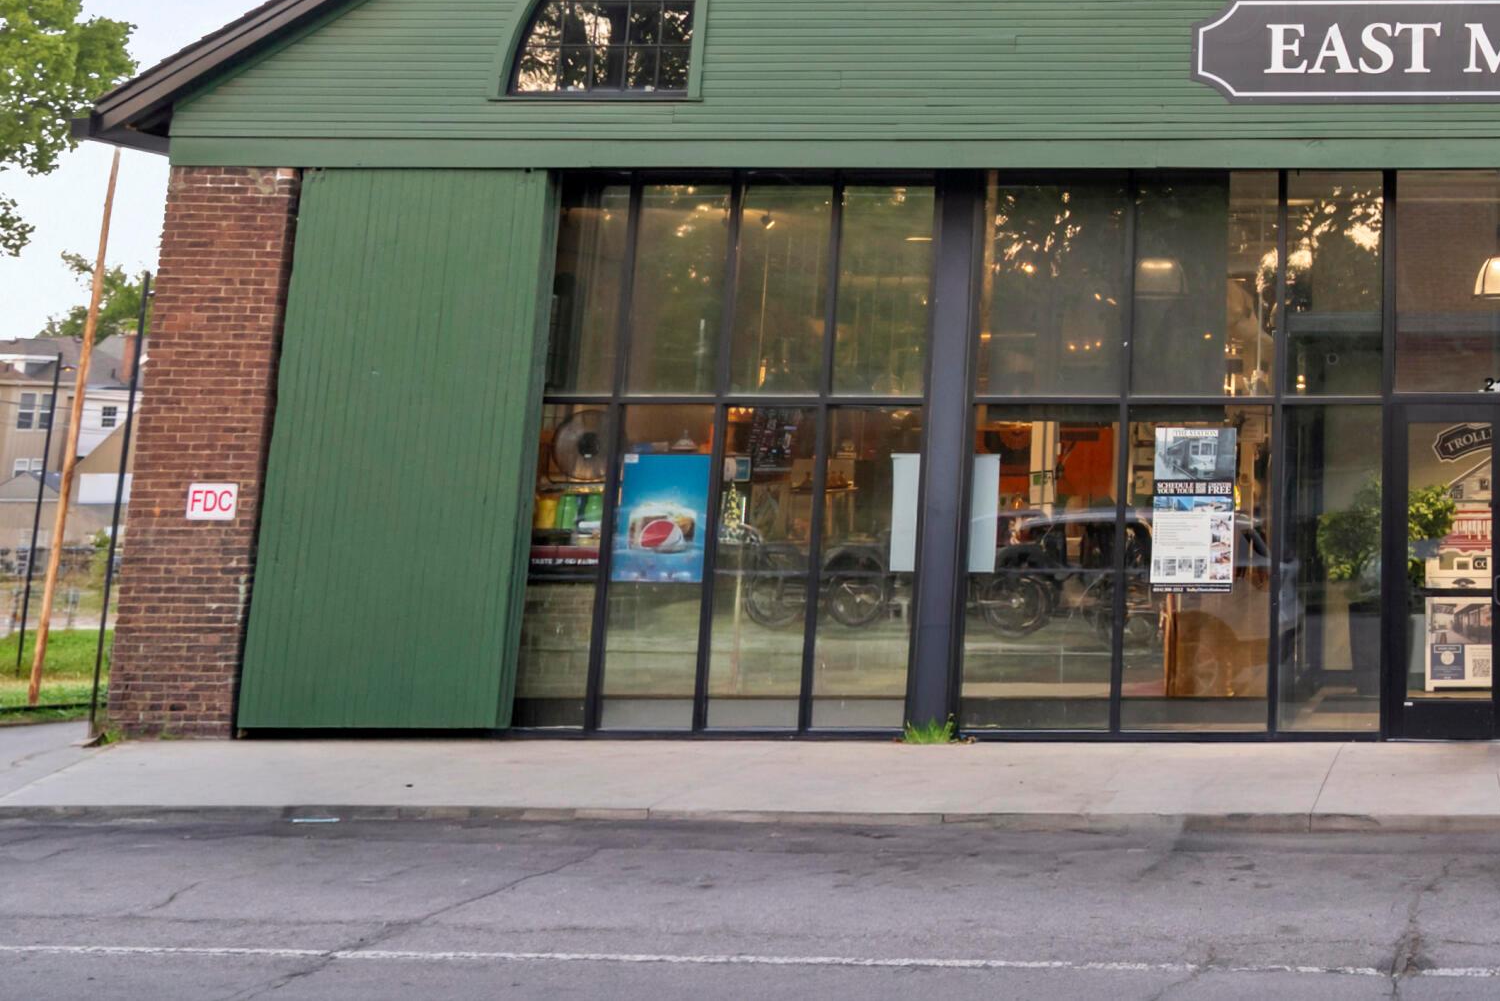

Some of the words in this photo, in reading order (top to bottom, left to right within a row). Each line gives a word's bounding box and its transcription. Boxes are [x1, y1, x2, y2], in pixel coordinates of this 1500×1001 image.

[1264, 22, 1441, 74] EAST
[190, 489, 233, 512] FDC
[1207, 486, 1232, 495] FREE
